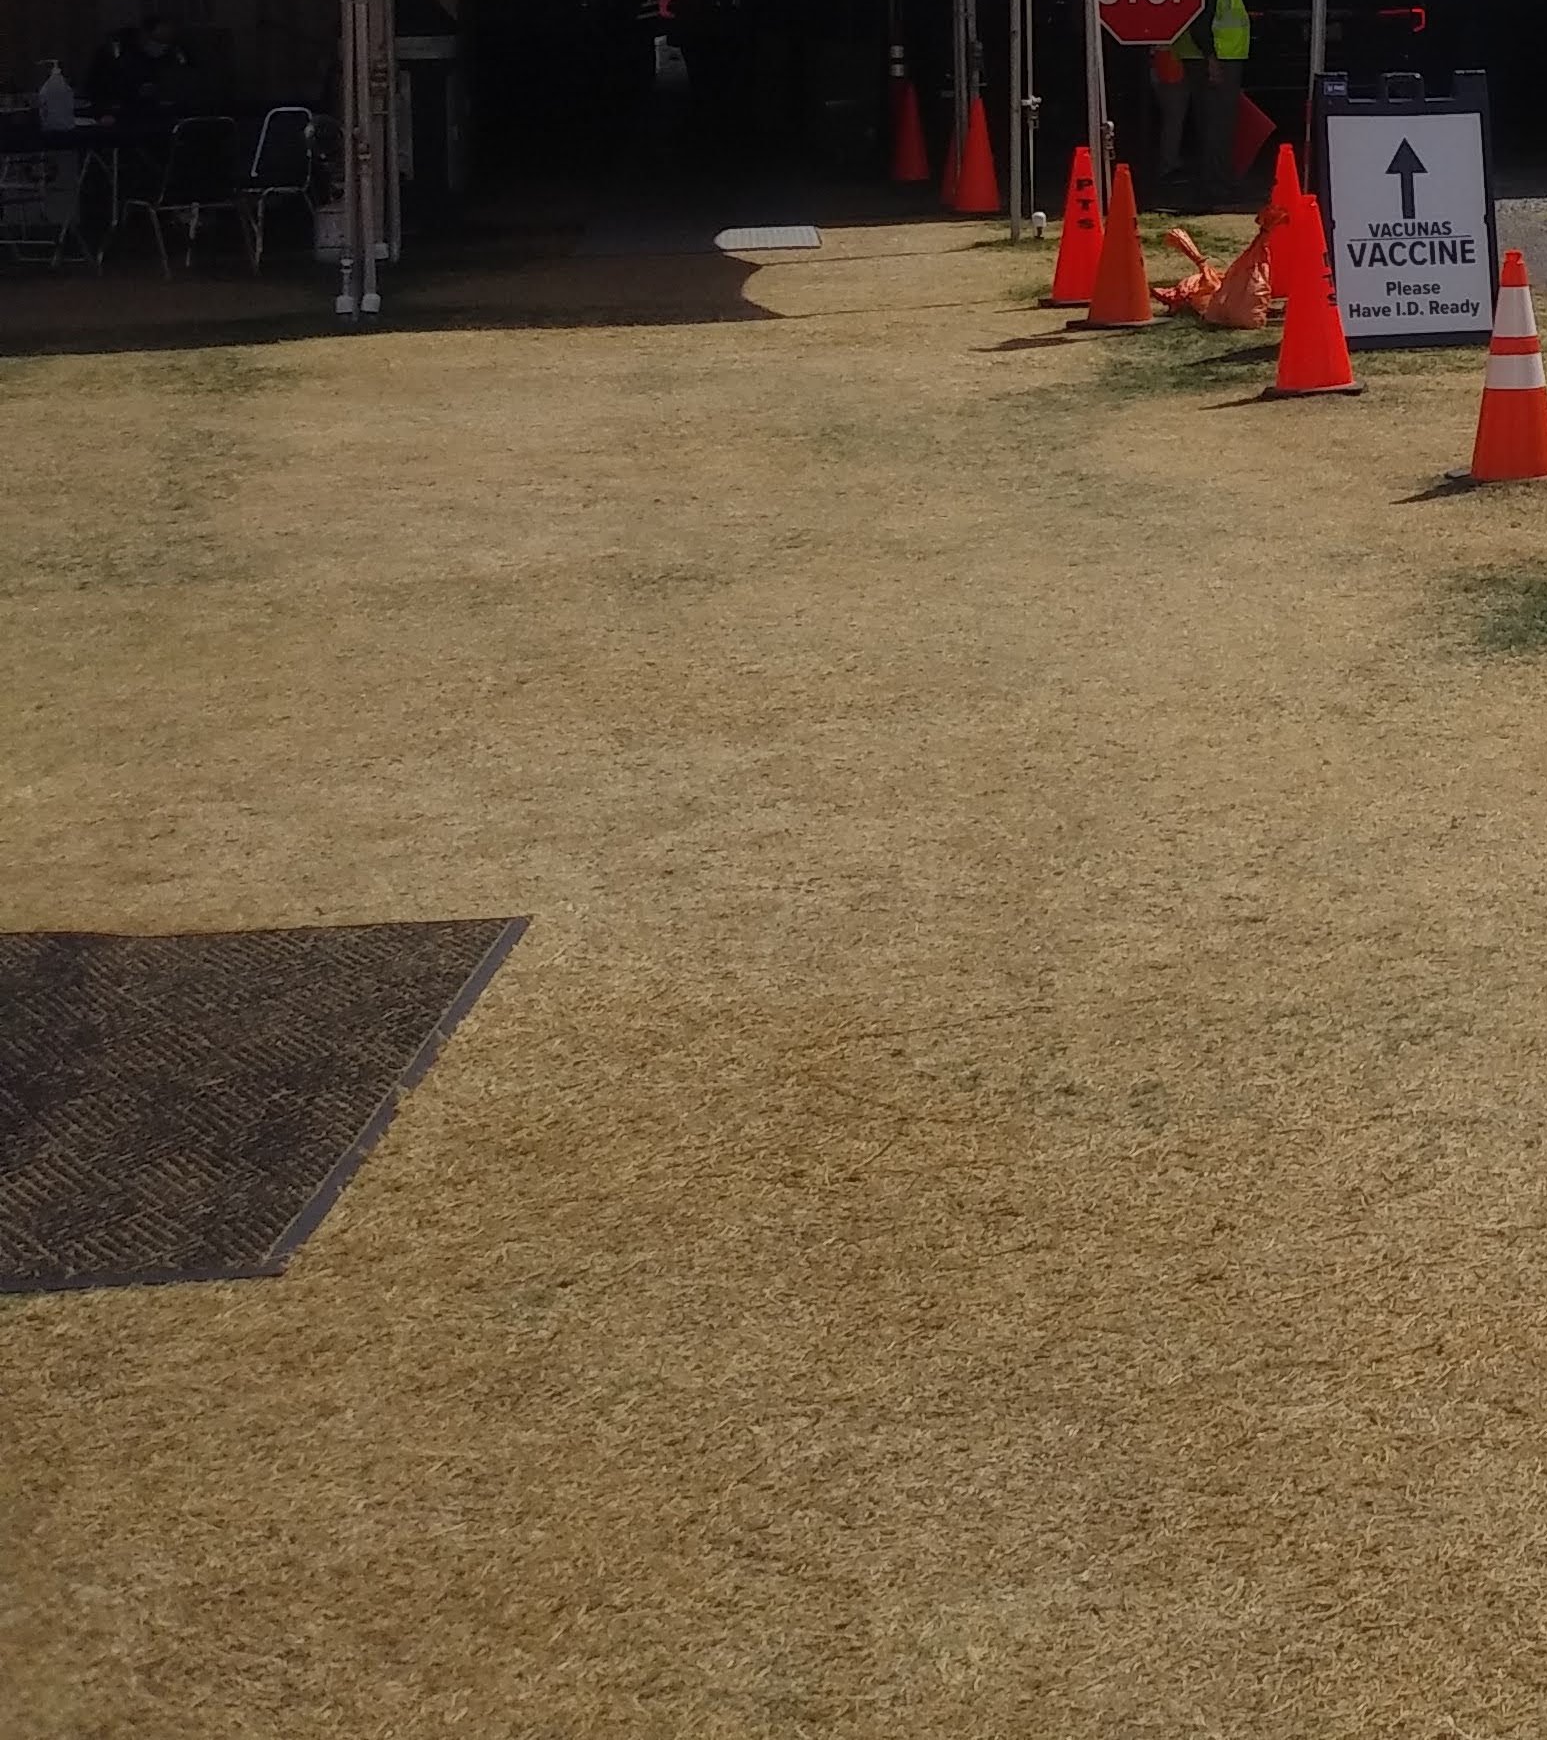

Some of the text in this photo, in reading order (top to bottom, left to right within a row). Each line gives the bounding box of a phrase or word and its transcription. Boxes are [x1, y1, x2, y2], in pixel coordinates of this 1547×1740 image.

[1368, 221, 1452, 238] VACUNAS
[1347, 240, 1476, 268] VACCINE
[1386, 281, 1441, 297] Please
[1349, 299, 1480, 318] Have I.D. Ready
